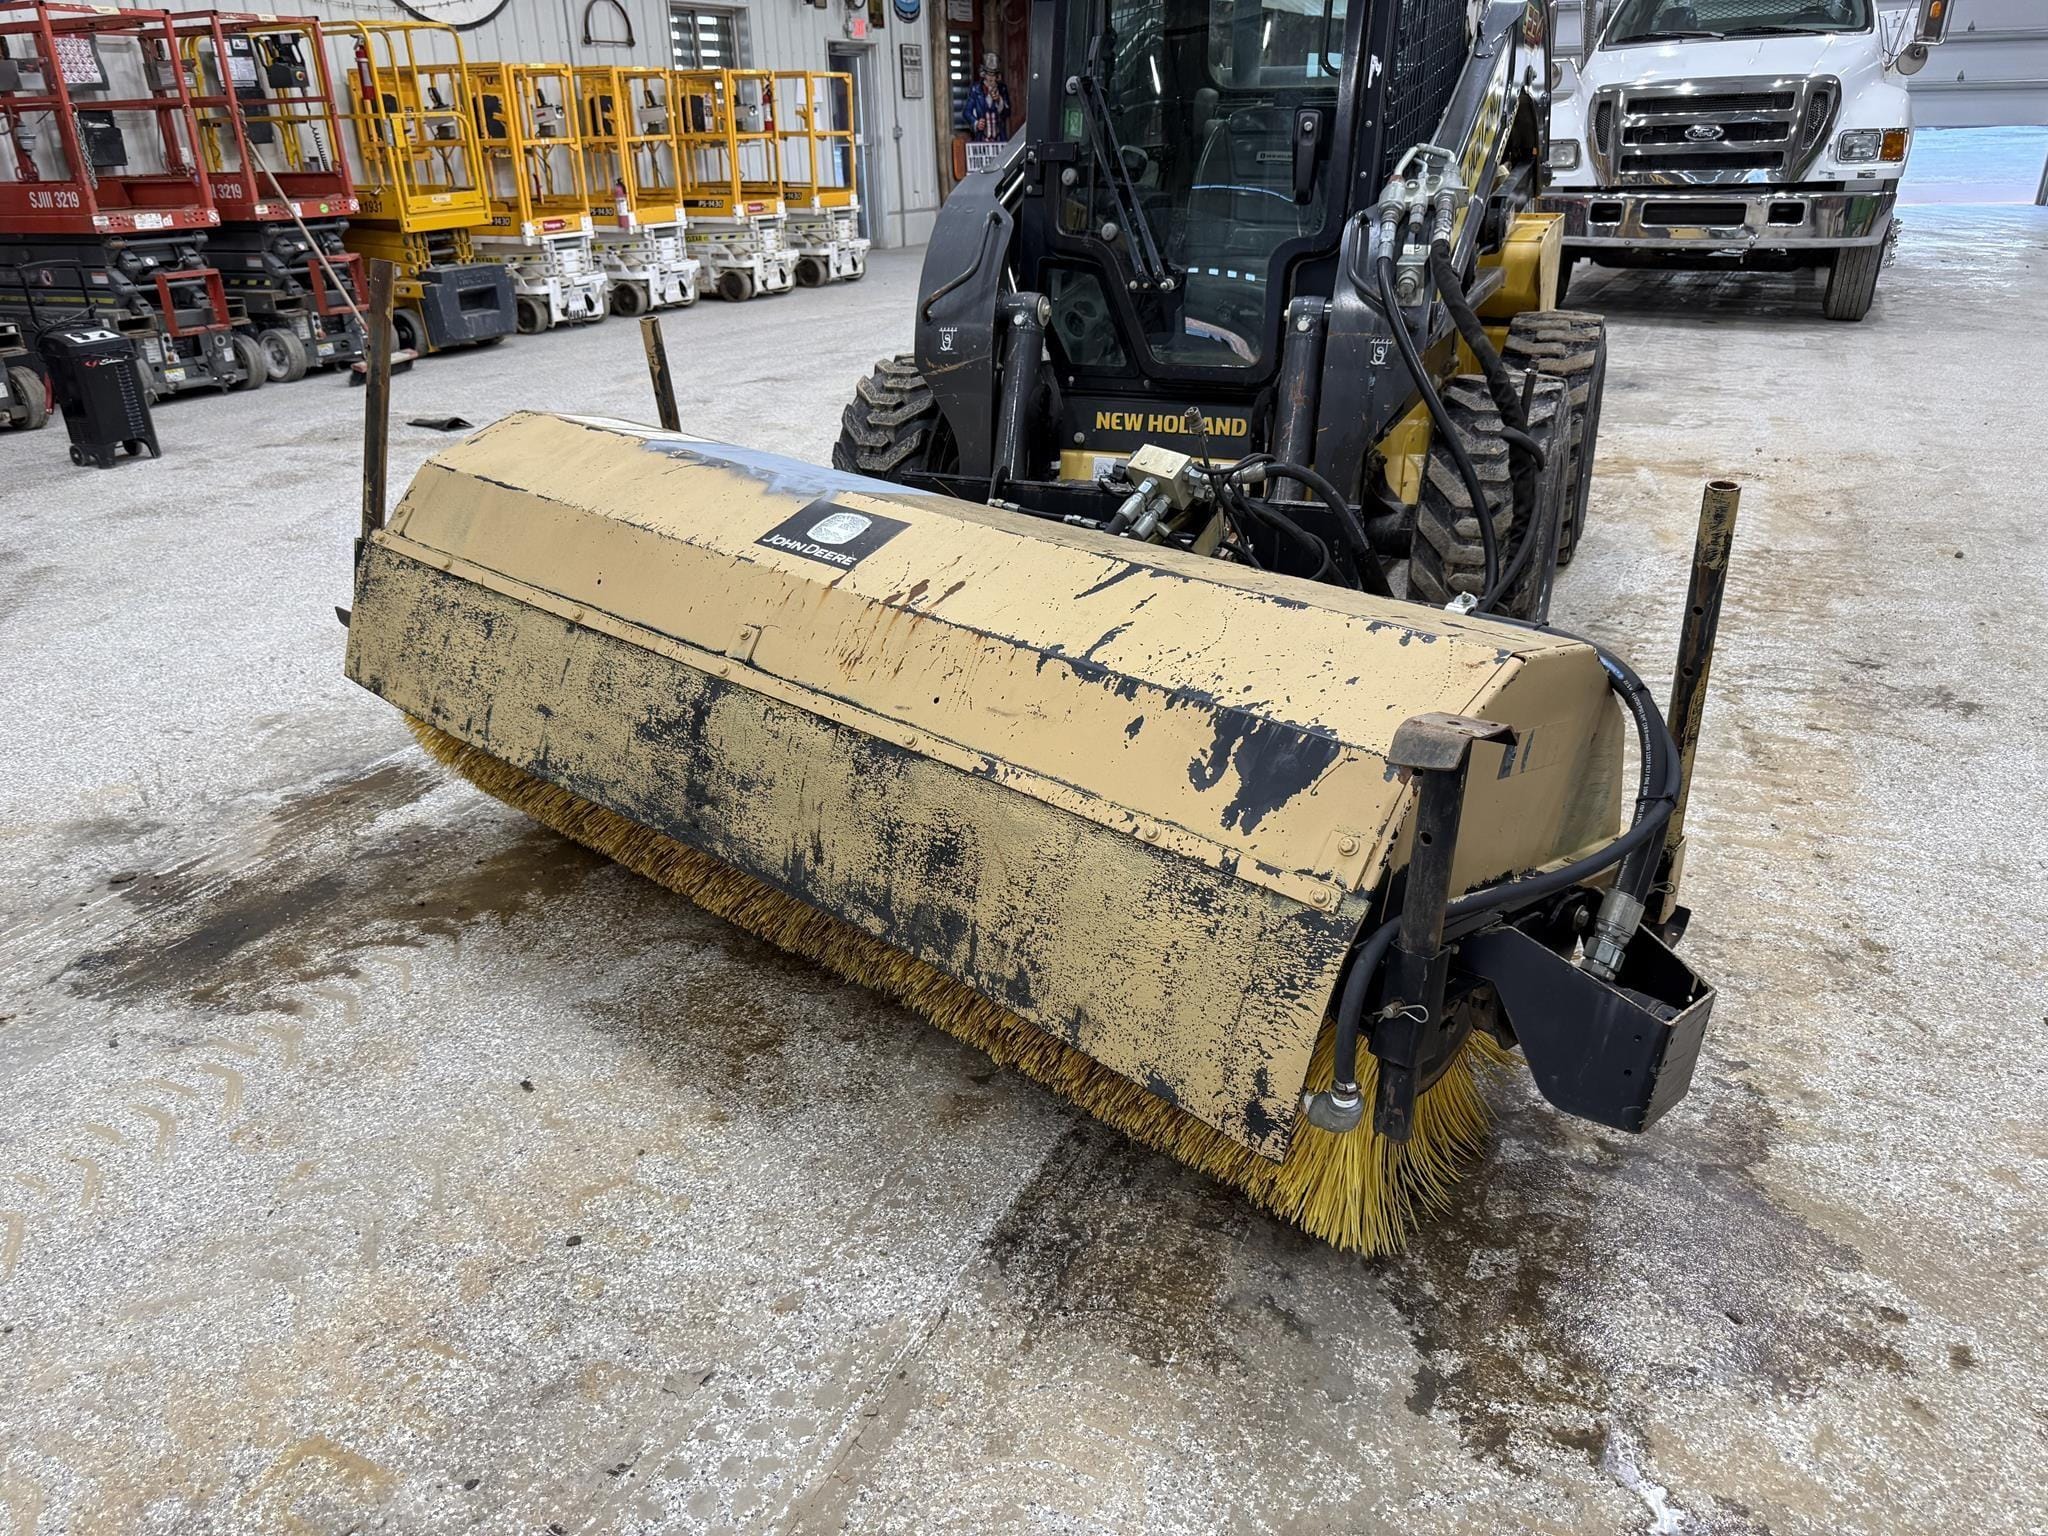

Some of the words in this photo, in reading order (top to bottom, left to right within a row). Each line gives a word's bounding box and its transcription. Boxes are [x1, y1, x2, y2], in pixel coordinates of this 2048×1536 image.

[29, 191, 53, 209] SJIII
[54, 191, 80, 209] 3219
[217, 183, 242, 199] 3219
[1096, 411, 1143, 432] NEW
[762, 533, 807, 552] JOHN
[803, 543, 858, 566] DEERE
